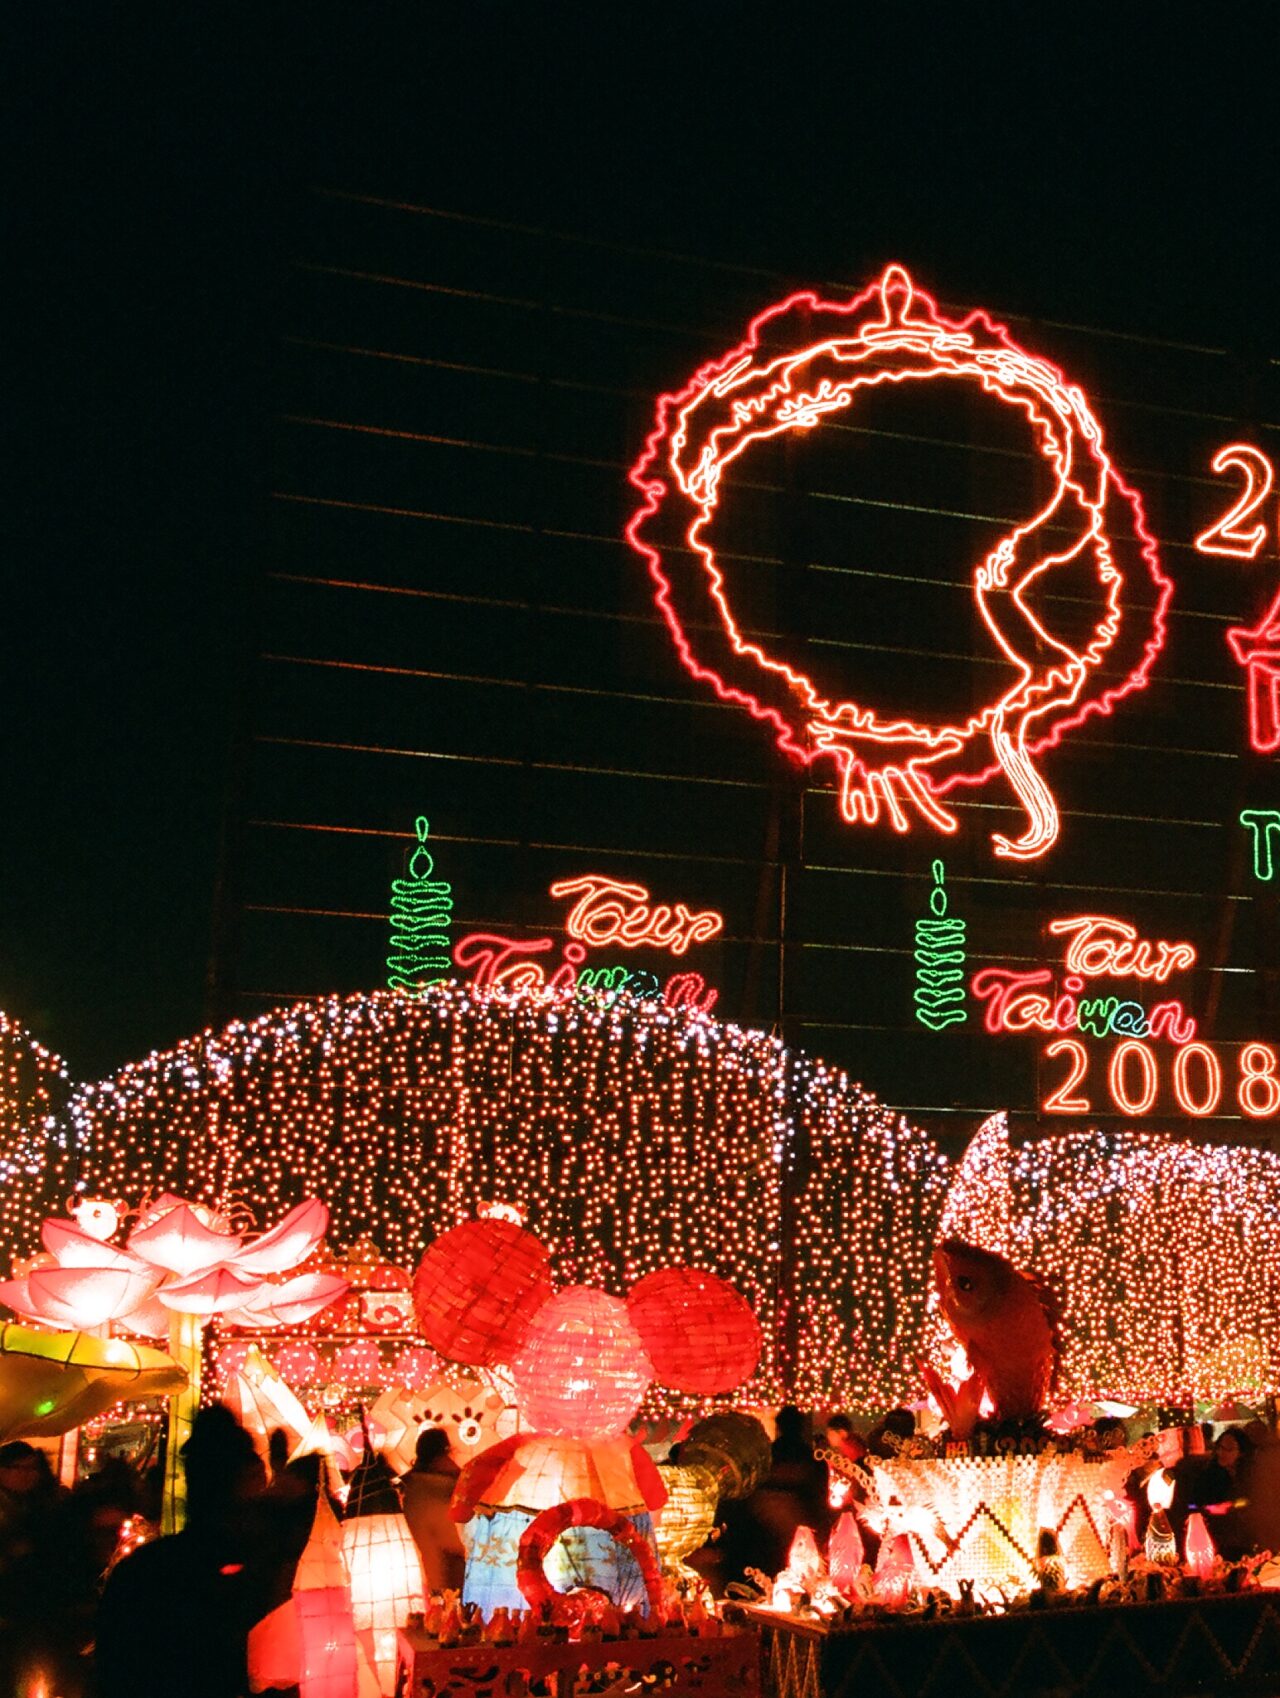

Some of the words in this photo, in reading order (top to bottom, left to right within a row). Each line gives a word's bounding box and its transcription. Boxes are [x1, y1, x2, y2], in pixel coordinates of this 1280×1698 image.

[550, 875, 723, 954] Tour
[1049, 916, 1196, 981] Tour
[971, 968, 1196, 1043] Taiwan
